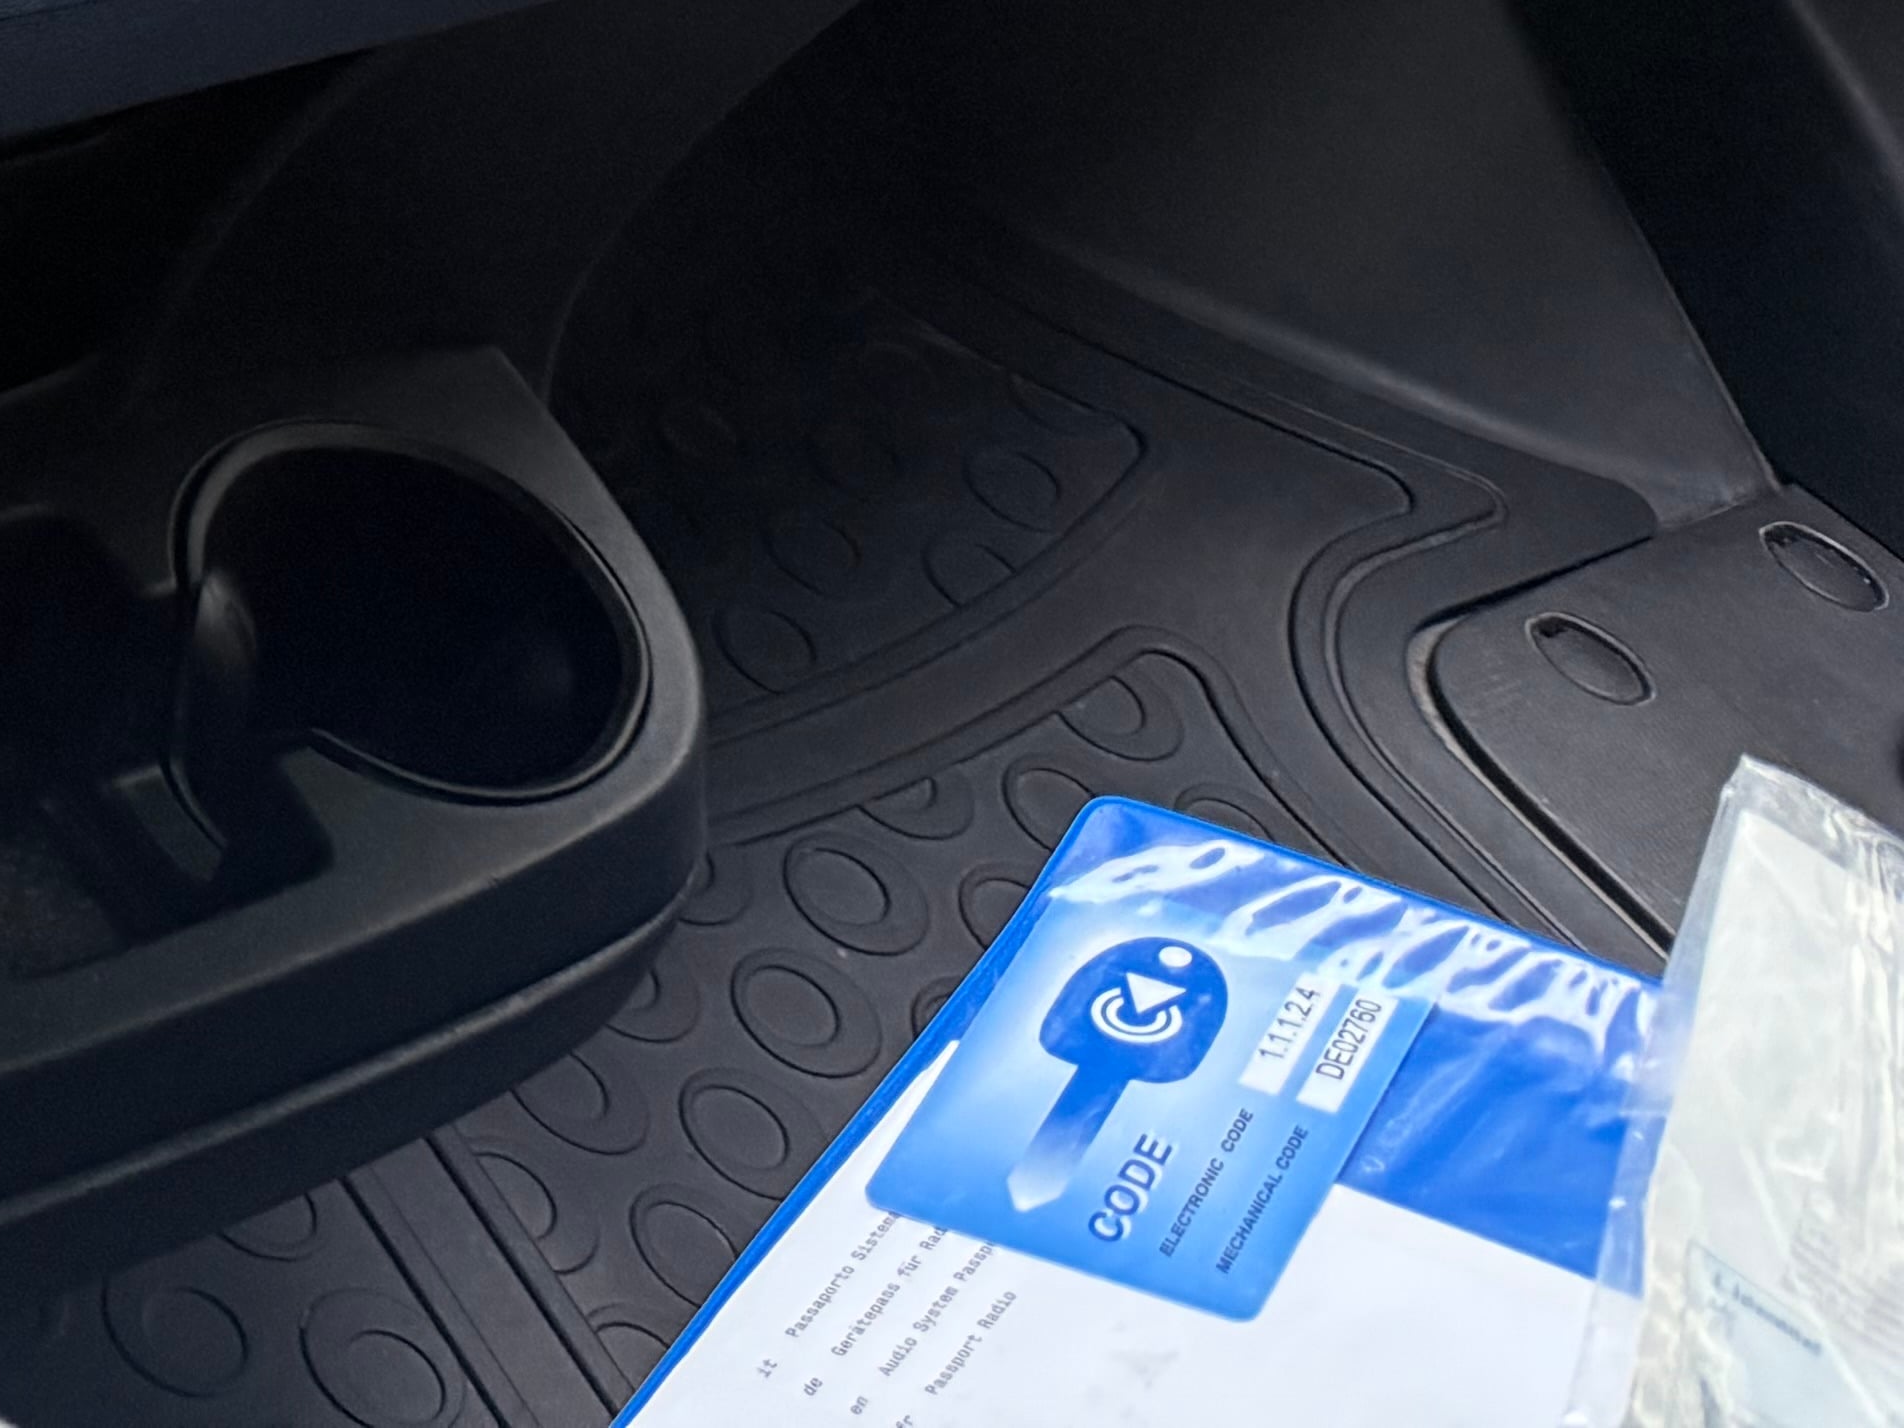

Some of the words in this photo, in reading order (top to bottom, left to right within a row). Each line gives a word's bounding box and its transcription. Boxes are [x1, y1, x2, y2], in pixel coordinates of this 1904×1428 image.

[1315, 998, 1383, 1080] DE02760
[1088, 1133, 1172, 1244] CODE
[1159, 1157, 1224, 1257] ELECTRONIC
[1220, 1108, 1254, 1153] CODE
[1215, 1173, 1283, 1274] MECHANICAL
[1274, 1125, 1309, 1171] CODE
[784, 1264, 855, 1338] Passaporto
[849, 1395, 869, 1416] en
[877, 1335, 918, 1377] Audio
[912, 1285, 959, 1334] System
[923, 1333, 983, 1396] Passport
[975, 1289, 1018, 1331] Radio
[803, 1376, 824, 1397] de
